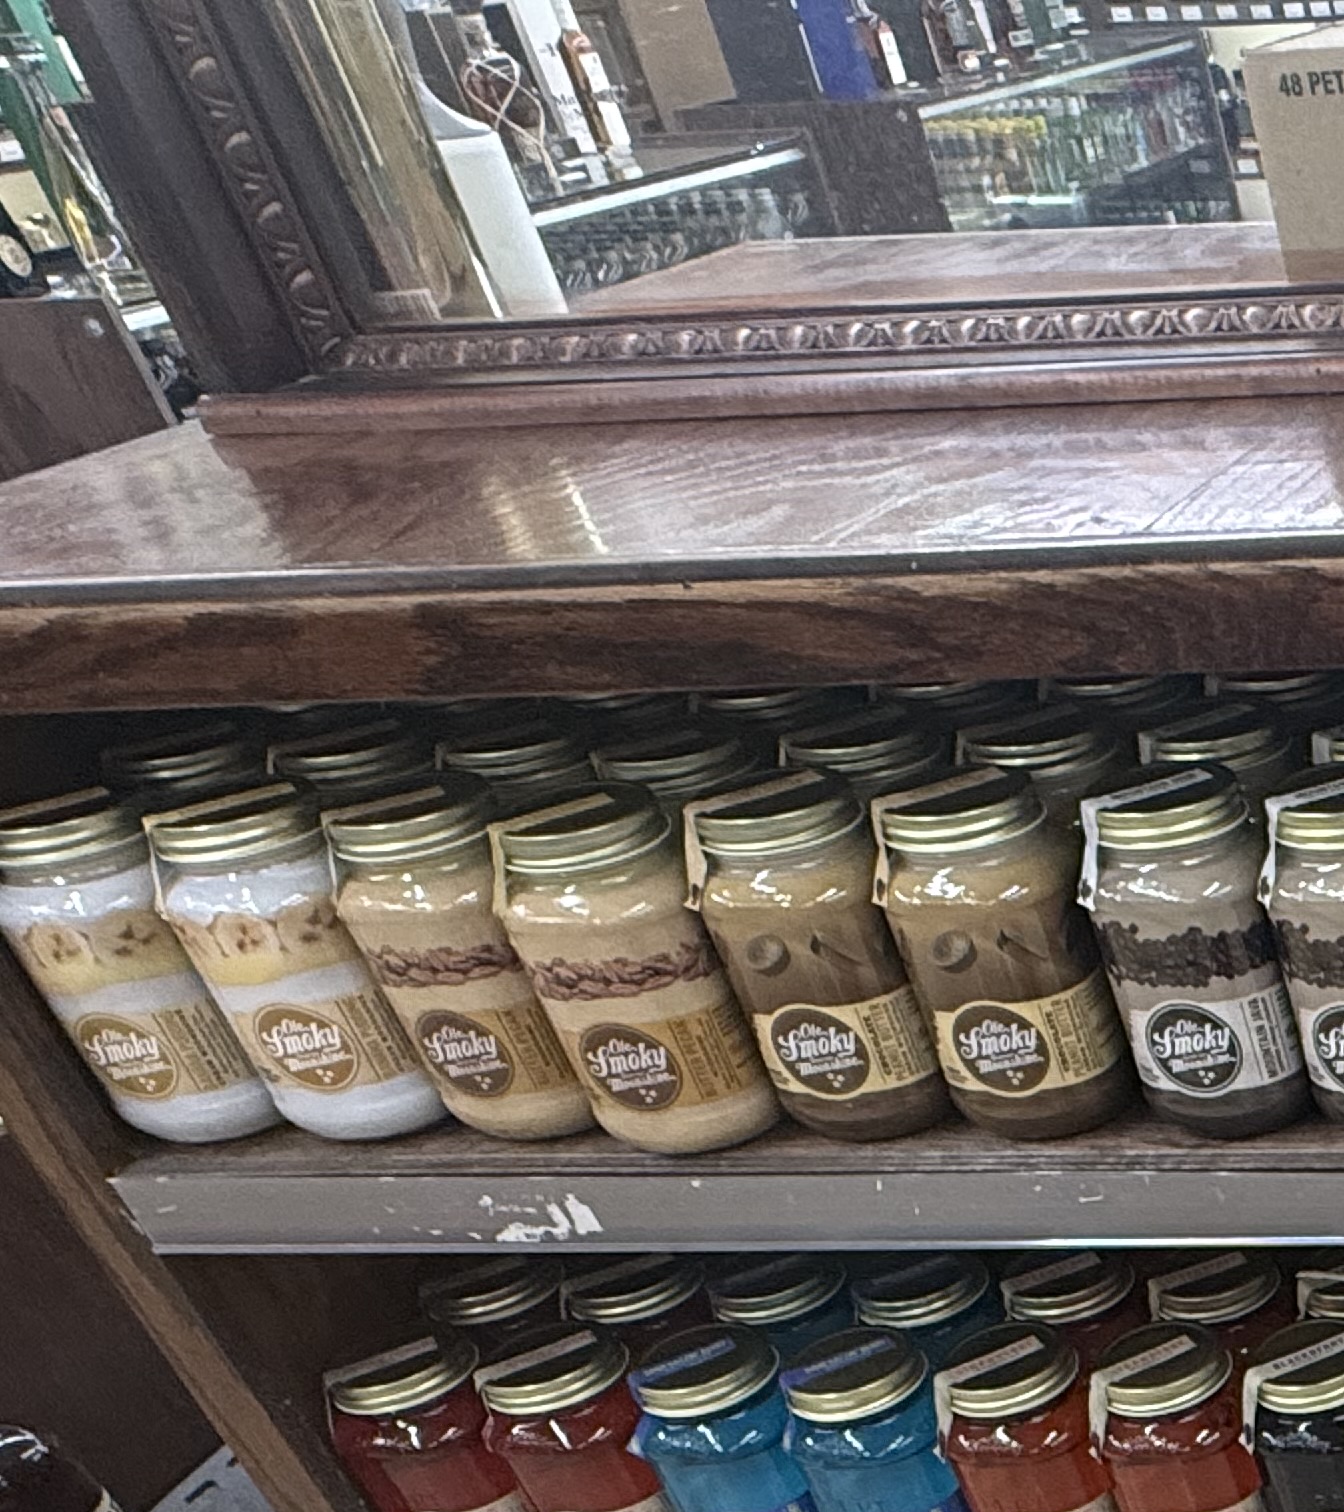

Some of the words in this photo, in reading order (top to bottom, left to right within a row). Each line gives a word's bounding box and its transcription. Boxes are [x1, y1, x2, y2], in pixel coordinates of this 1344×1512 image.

[1279, 75, 1302, 97] 48
[1307, 71, 1344, 95] PET
[85, 1031, 159, 1064] Smoky
[263, 1023, 340, 1057] Smoky
[423, 1028, 497, 1061] Smoky
[777, 1028, 855, 1061] Smoky
[959, 1024, 1036, 1058] Smoky
[1153, 1024, 1231, 1057] Smoky
[587, 1042, 668, 1076] Smoky
